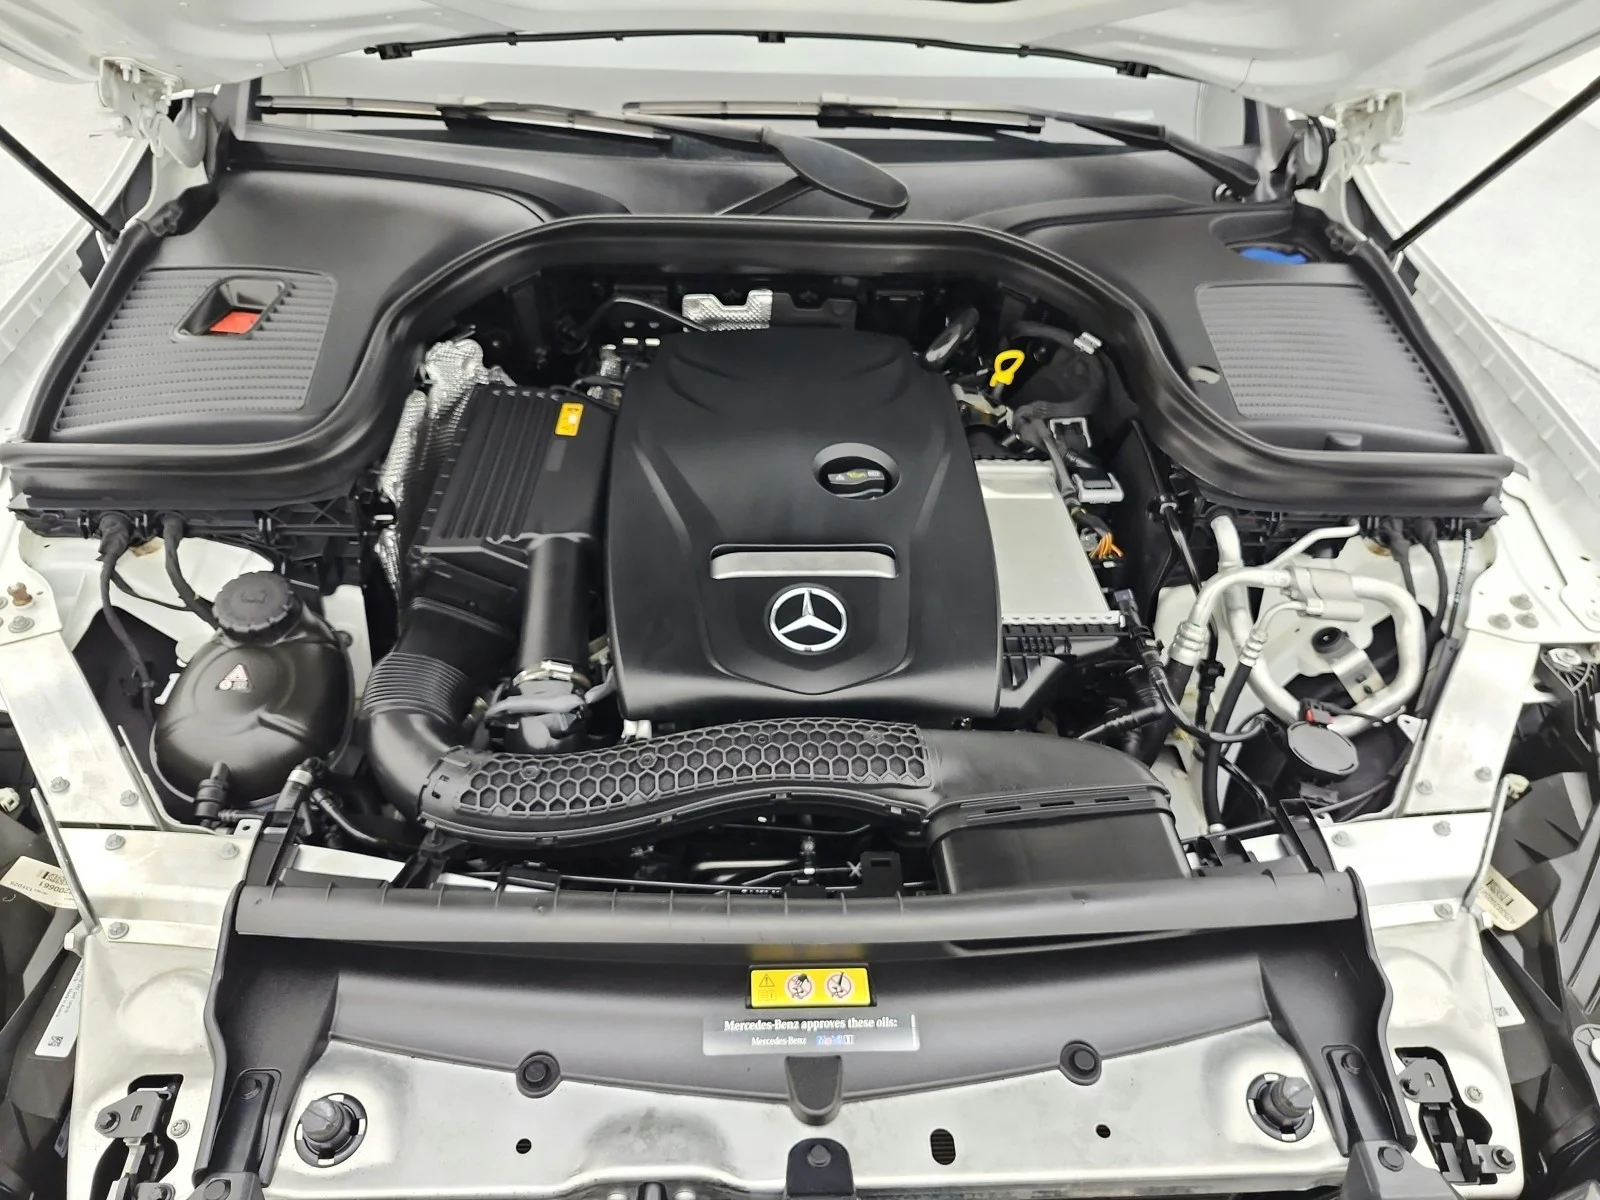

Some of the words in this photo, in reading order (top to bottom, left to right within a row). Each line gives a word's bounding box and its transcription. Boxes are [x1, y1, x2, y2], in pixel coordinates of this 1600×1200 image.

[724, 1019, 800, 1031] Mercedes-Benz
[801, 1020, 846, 1032] approves
[847, 1017, 875, 1029] these
[876, 1016, 898, 1028] oils:
[751, 1035, 807, 1046] Mercedes-Benz
